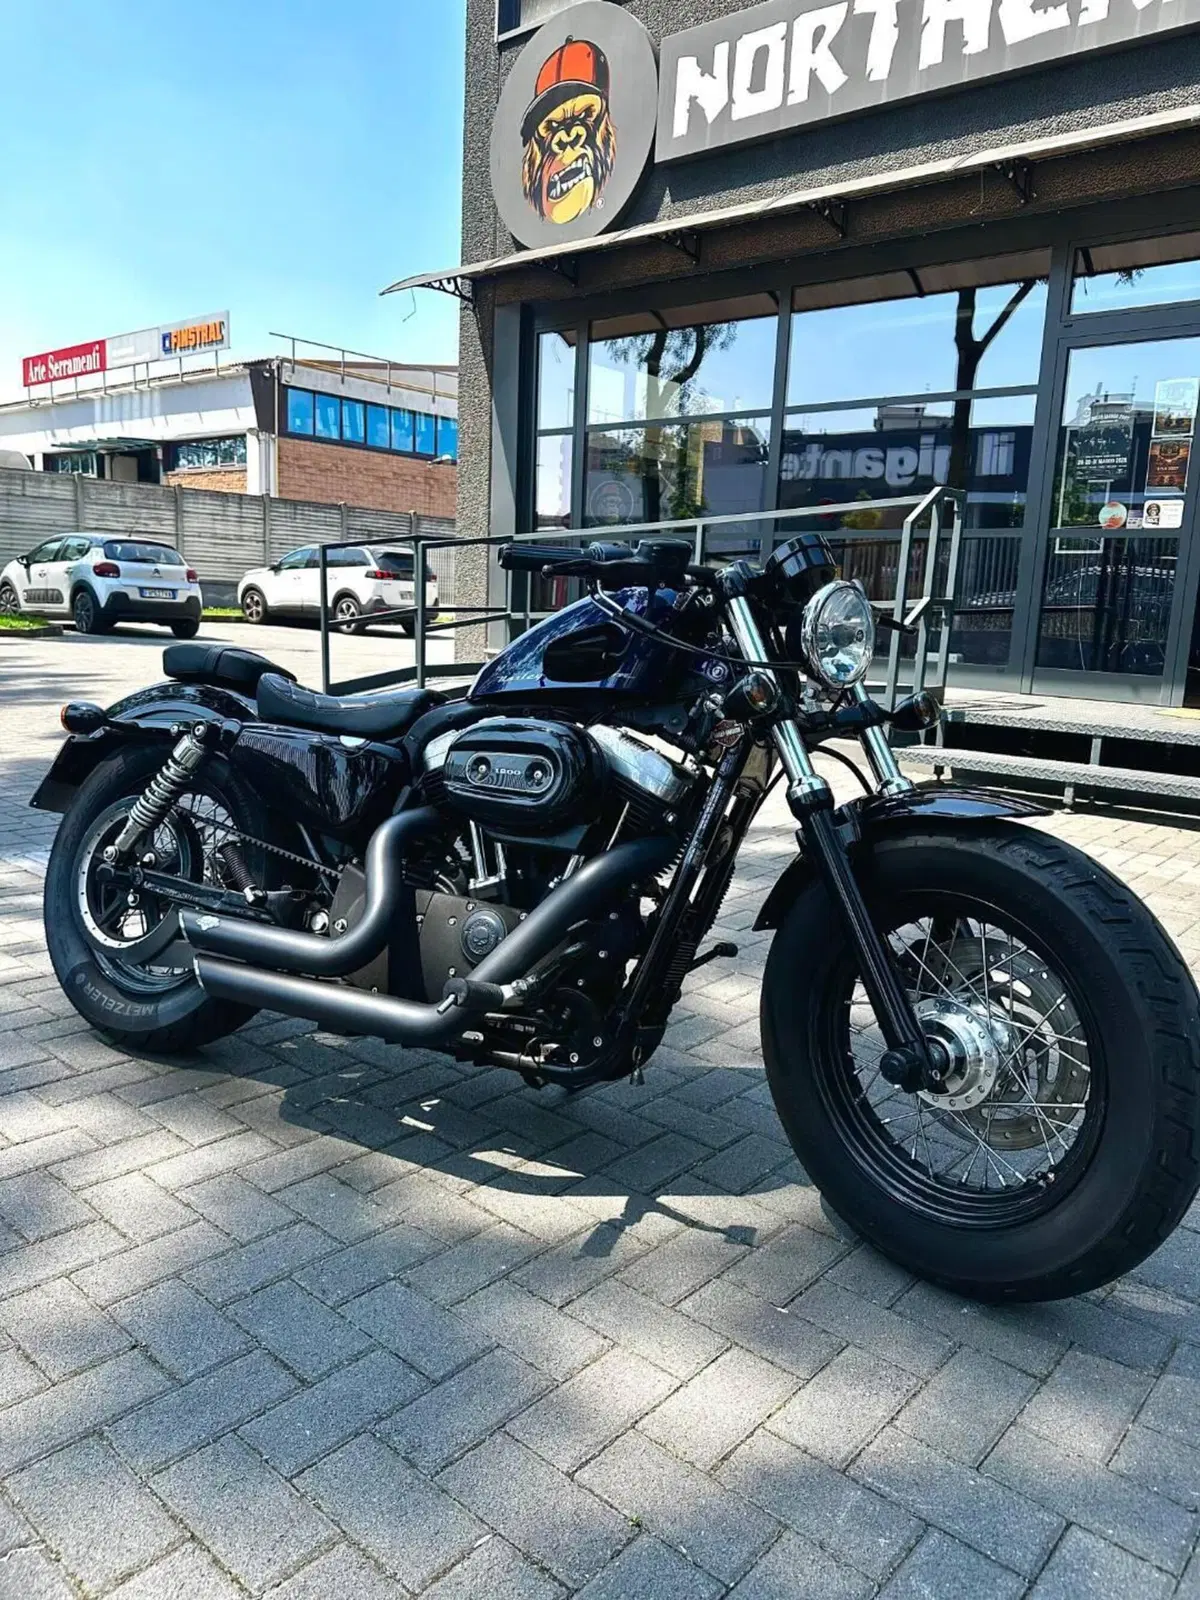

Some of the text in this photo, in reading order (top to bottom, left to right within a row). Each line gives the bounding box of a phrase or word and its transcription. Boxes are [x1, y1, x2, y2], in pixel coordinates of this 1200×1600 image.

[672, 0, 1182, 138] NORTH
[171, 321, 224, 350] FINSTRAL
[28, 344, 100, 383] Arte Serramenti
[495, 768, 521, 776] 1200
[82, 981, 155, 1016] METZELER
